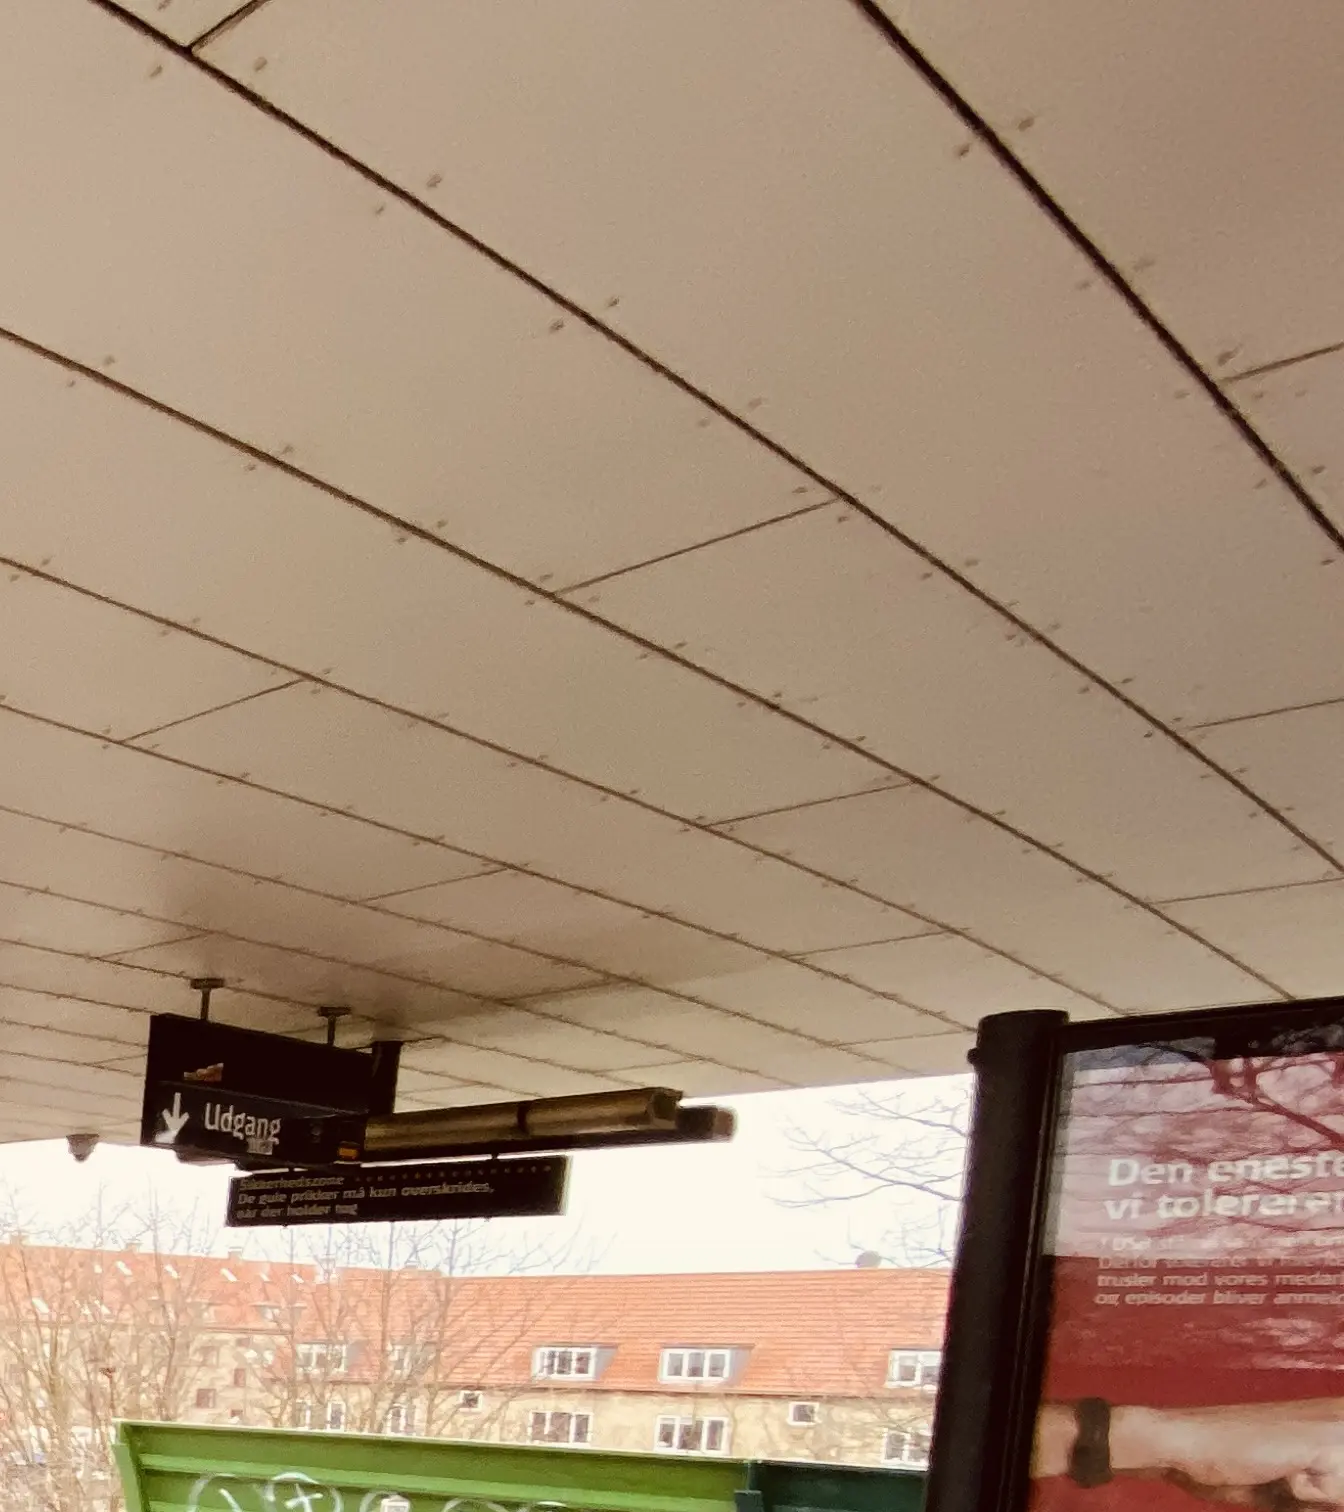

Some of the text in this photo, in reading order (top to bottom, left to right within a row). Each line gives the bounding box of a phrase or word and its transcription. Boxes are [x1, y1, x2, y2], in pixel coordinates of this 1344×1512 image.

[204, 1102, 282, 1145] Udgang
[1109, 1157, 1193, 1186] Den
[369, 1186, 397, 1198] kun
[1104, 1191, 1143, 1219] vi
[1163, 1271, 1208, 1287] mod
[1214, 1274, 1268, 1287] vores
[1124, 1290, 1206, 1306] episoder
[1213, 1290, 1267, 1306] bliver
